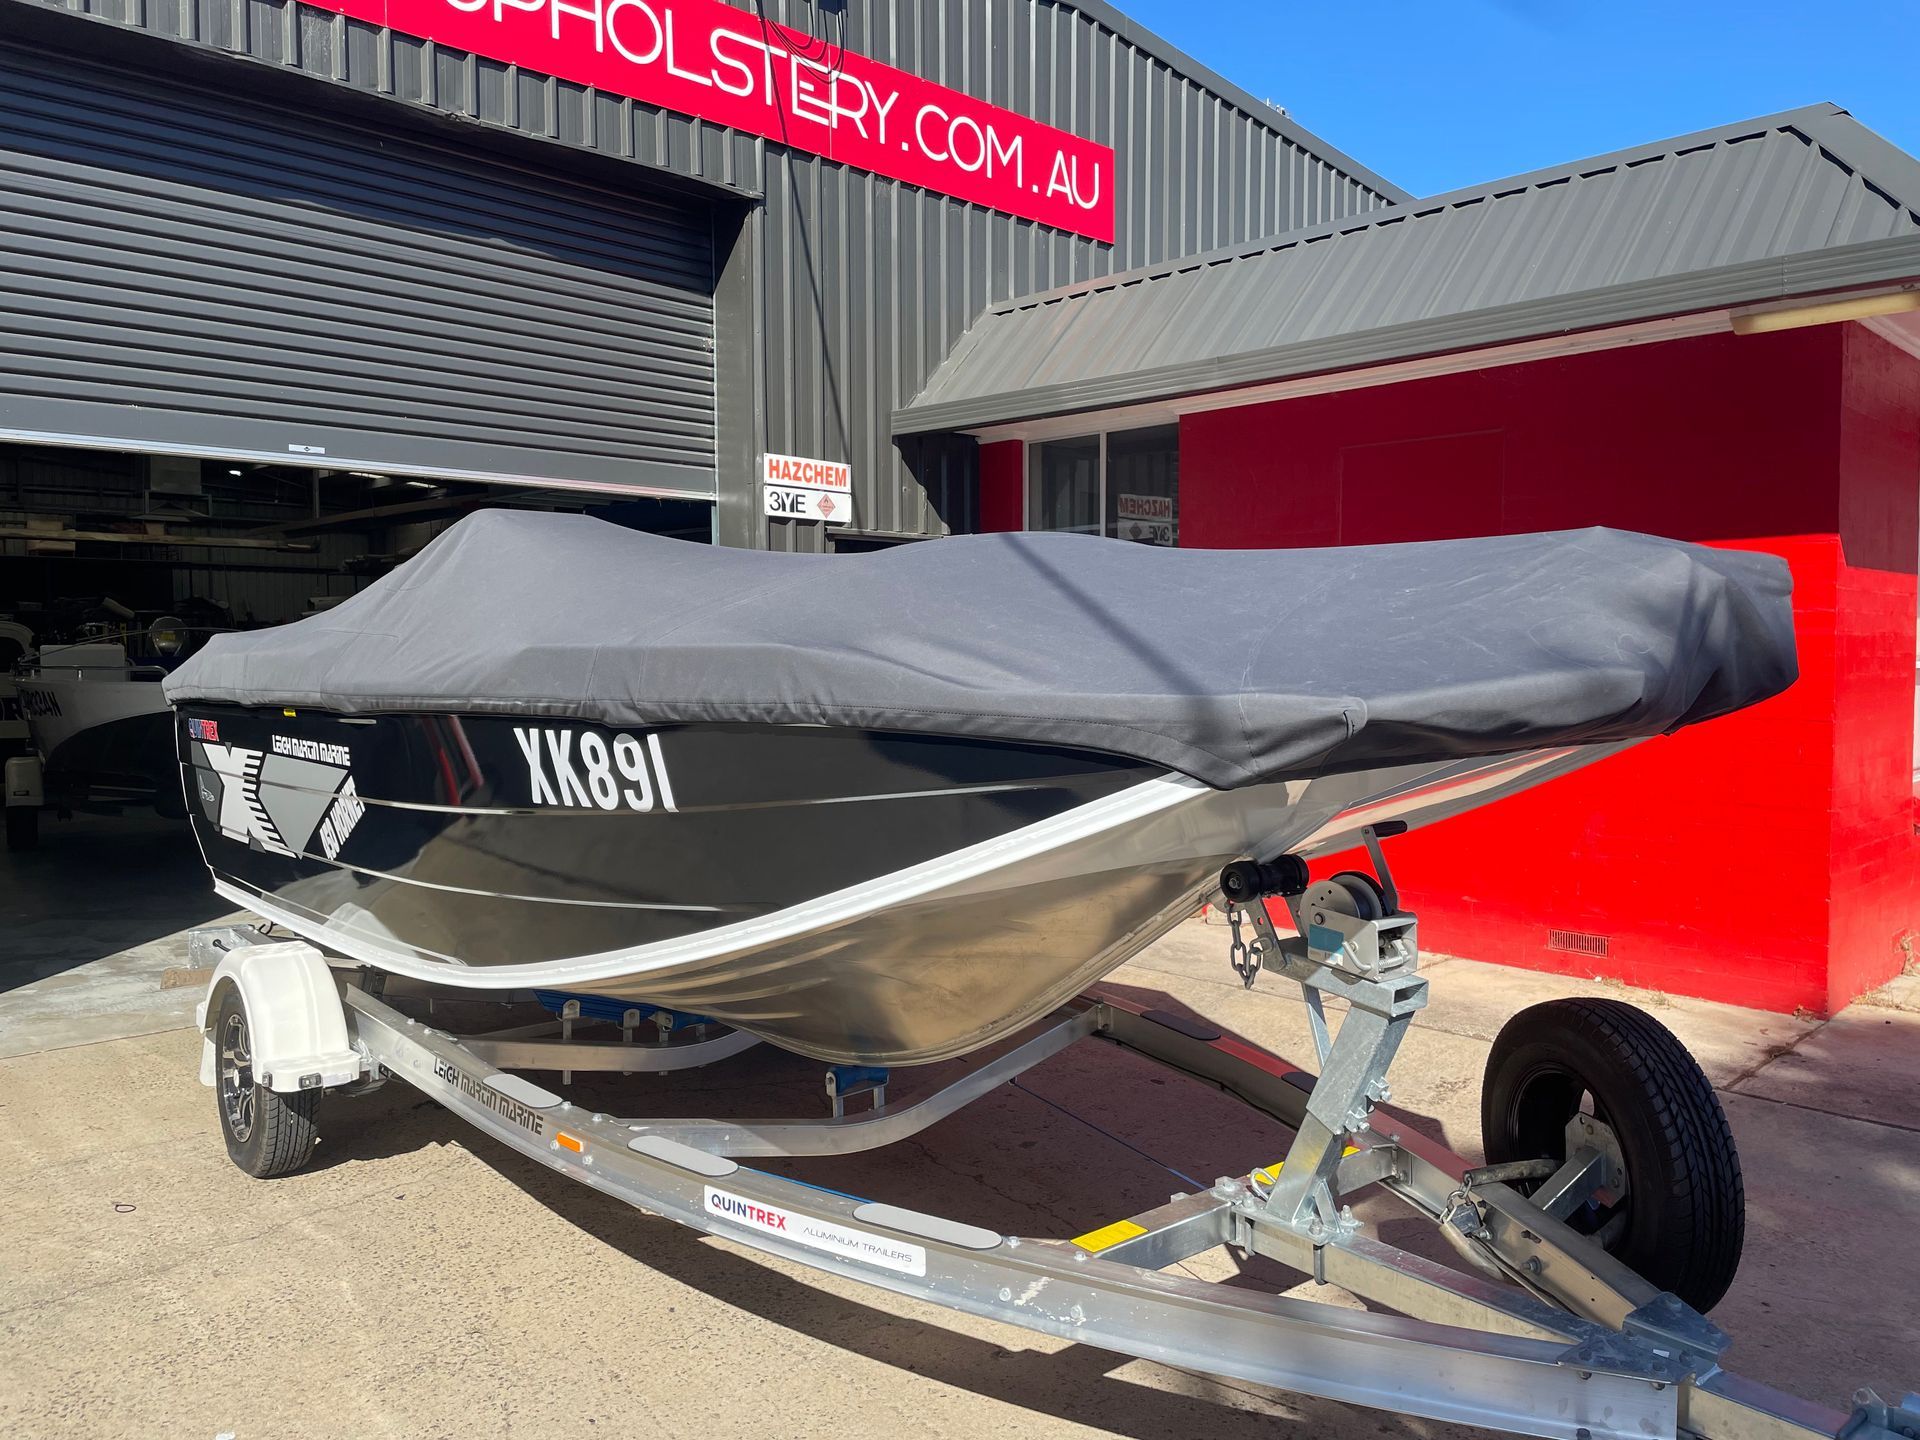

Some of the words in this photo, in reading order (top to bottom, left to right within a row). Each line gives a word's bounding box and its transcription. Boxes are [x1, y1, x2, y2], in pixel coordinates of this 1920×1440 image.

[768, 458, 847, 487] HAZCHEM
[769, 491, 807, 513] 3YE
[188, 717, 220, 742] QUINTREX
[711, 1193, 787, 1231] QUINTREX
[803, 1226, 859, 1249] ALUMINIUM
[862, 1243, 913, 1263] TRAILERS
